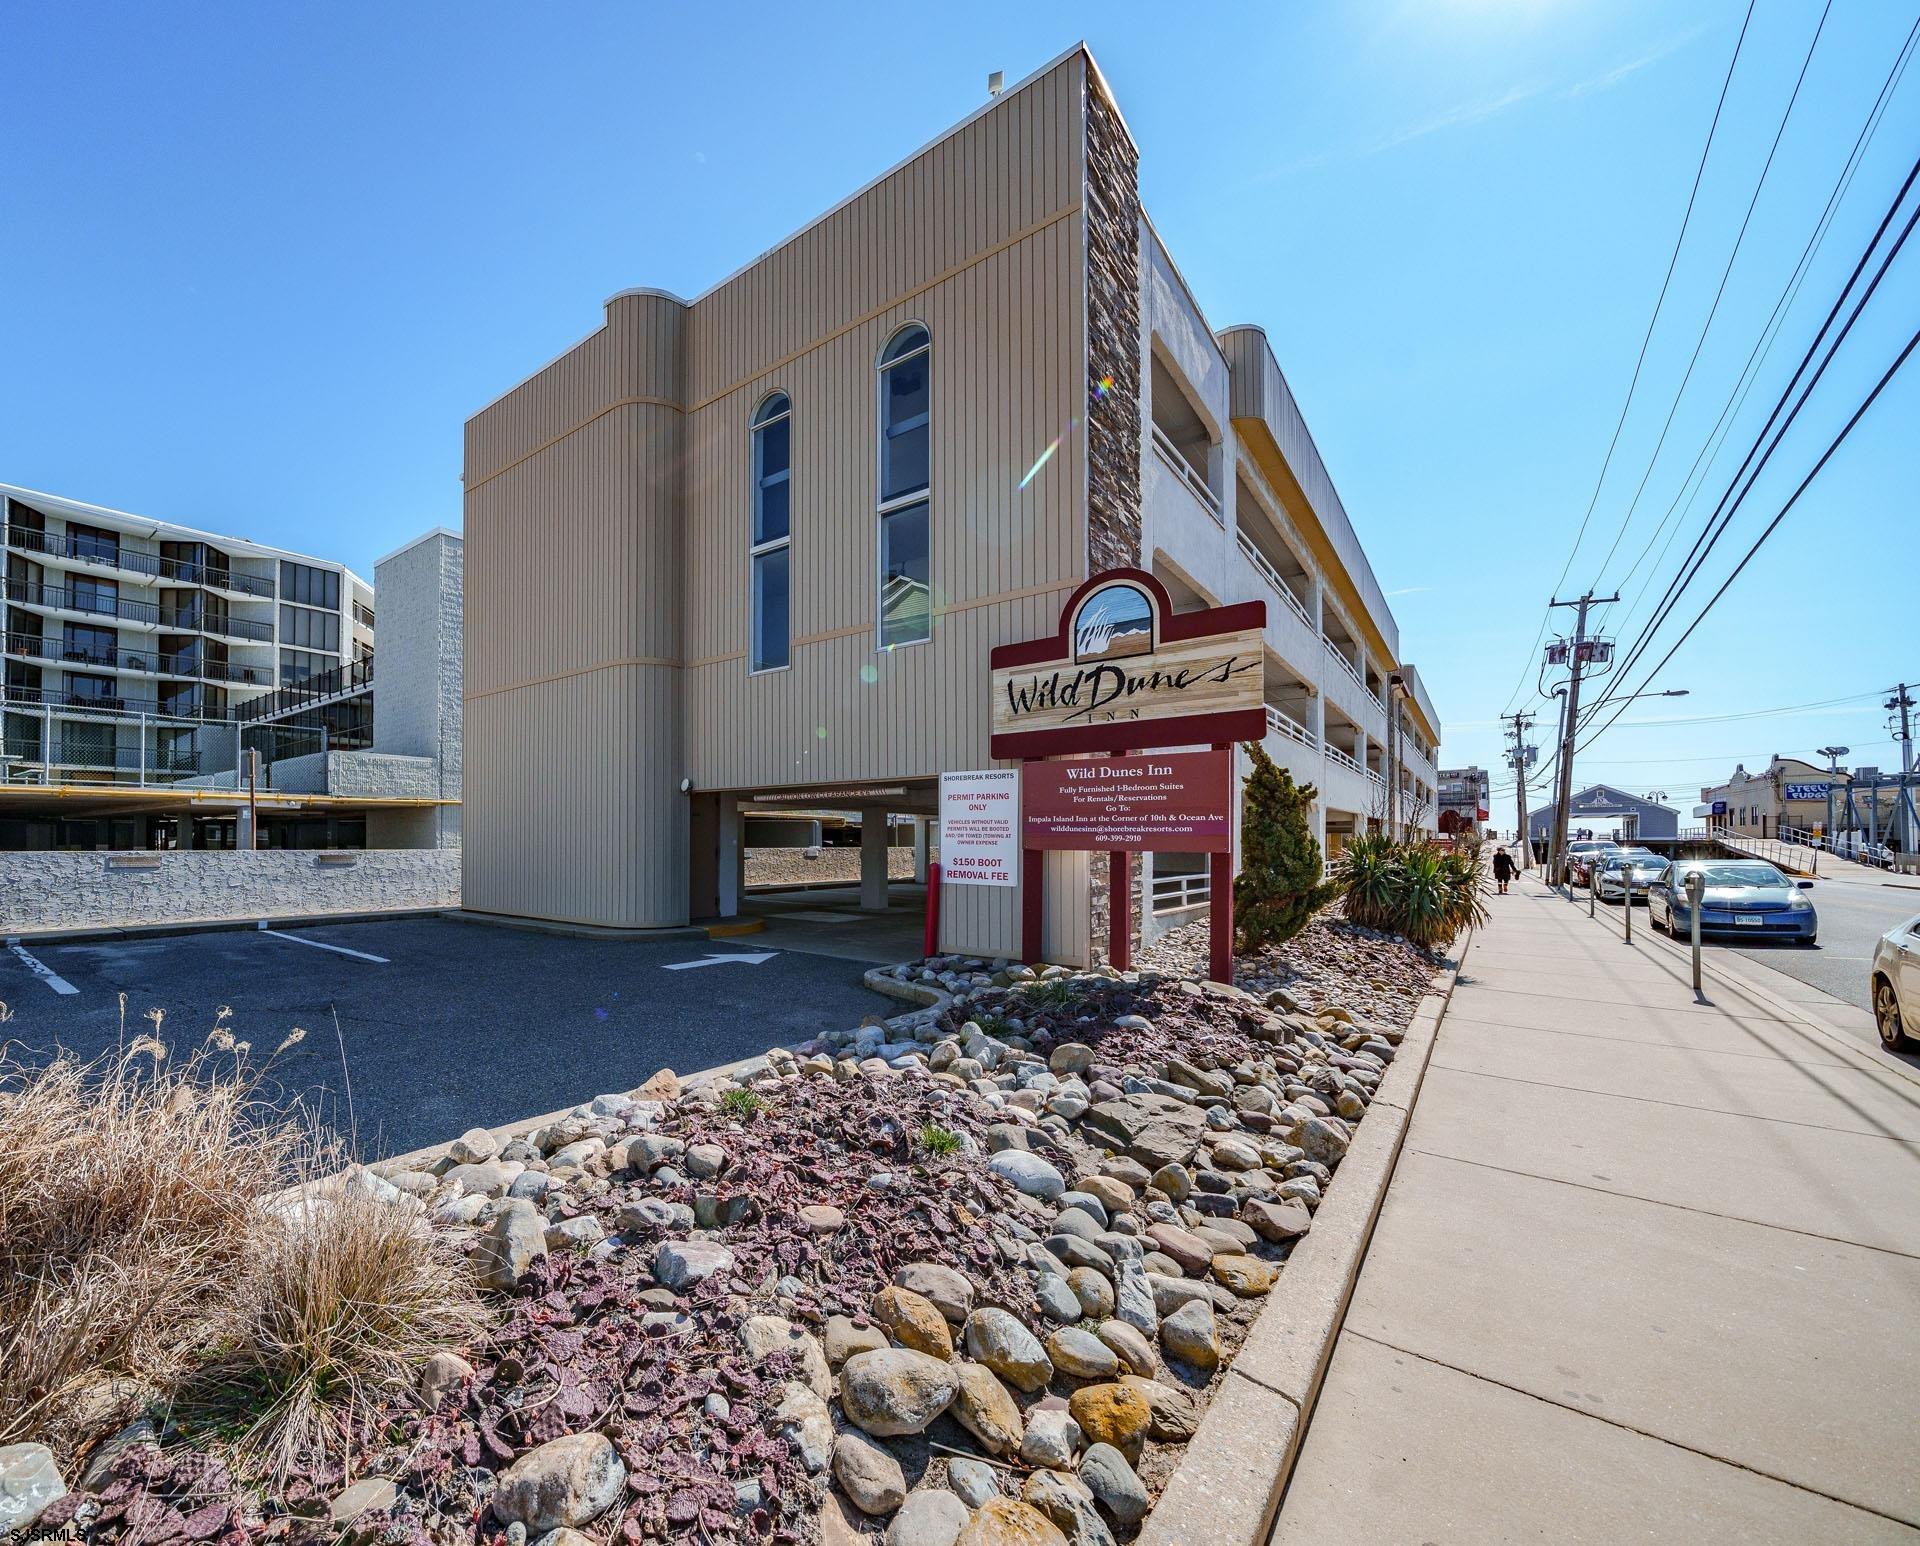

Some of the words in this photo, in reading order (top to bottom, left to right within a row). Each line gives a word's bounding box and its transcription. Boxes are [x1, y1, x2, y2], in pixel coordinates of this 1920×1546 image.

[1007, 669, 1084, 714] Wild
[1062, 657, 1262, 722] Dunes
[1088, 708, 1140, 724] INN
[1066, 767, 1095, 779] Wild
[1100, 767, 1143, 778] Dunes
[1147, 764, 1173, 776] Inn
[1059, 786, 1077, 795] Fully
[1078, 785, 1115, 793] Furnished
[948, 793, 975, 801] PERMIT
[1087, 793, 1167, 803] Rentals/Reservations
[1119, 804, 1131, 812] To:
[1028, 816, 1051, 824] Impala
[1208, 813, 1224, 821] Ave
[1050, 825, 1193, 834] wilddunesinn@shorebreakresorts.com
[1095, 834, 1142, 842] 609-399-2910
[953, 857, 976, 867] $150
[978, 858, 1003, 868] BOOT
[947, 870, 988, 880] REMOVAL
[991, 872, 1009, 881] FEE
